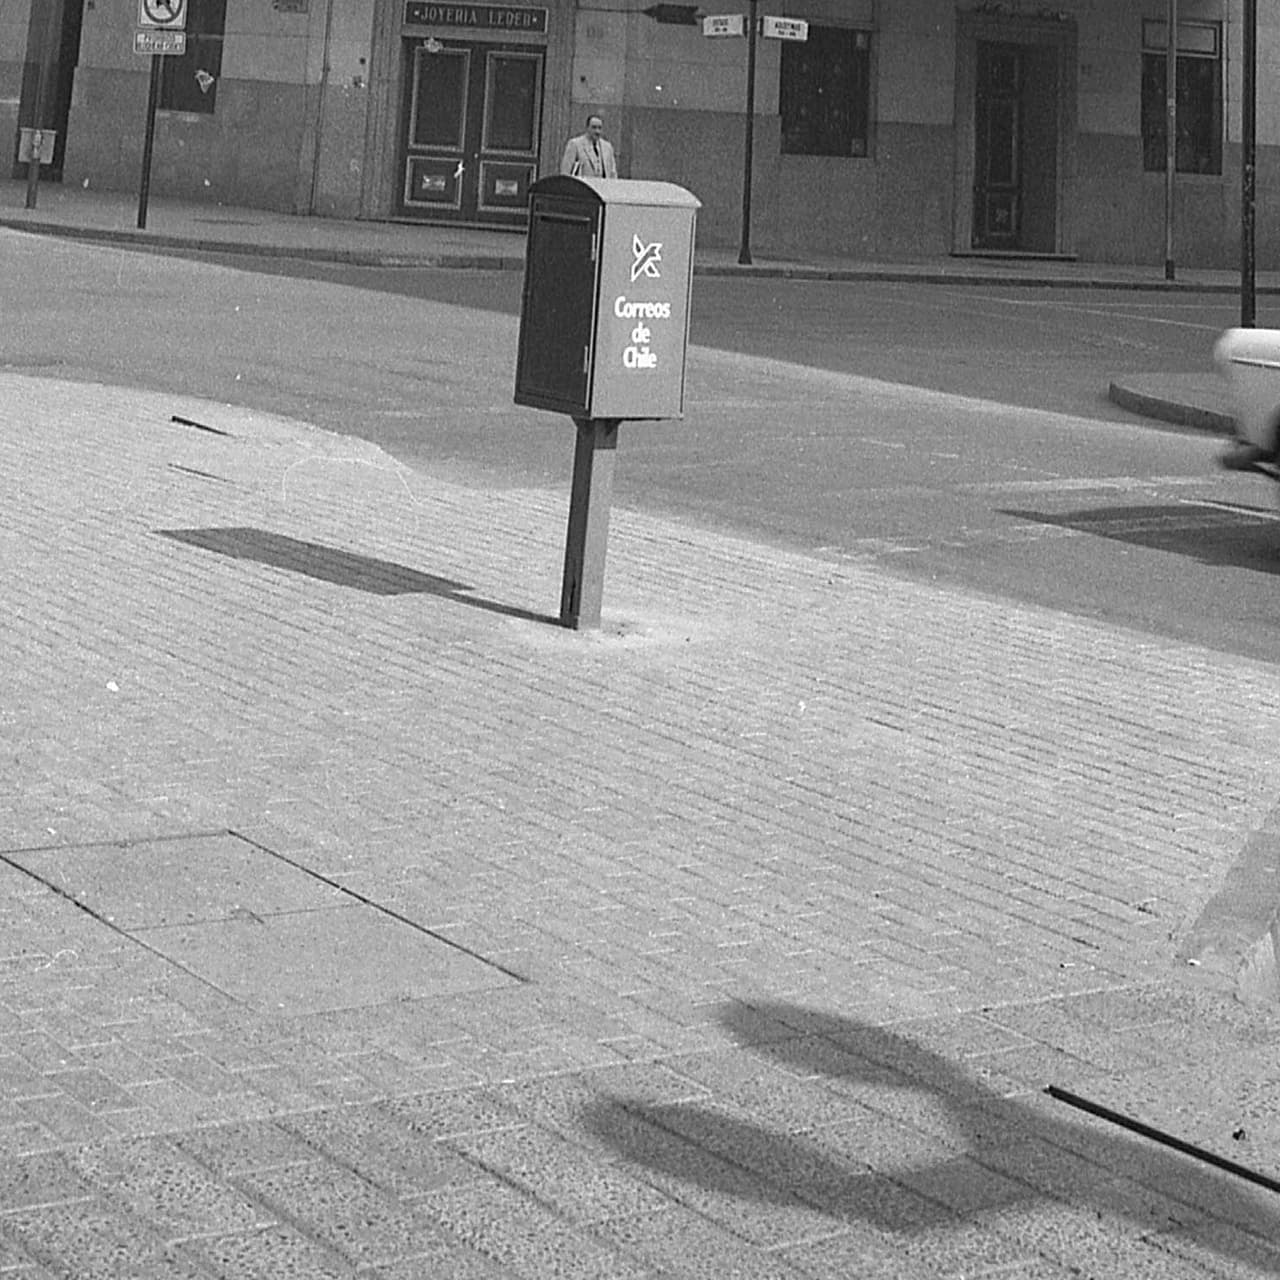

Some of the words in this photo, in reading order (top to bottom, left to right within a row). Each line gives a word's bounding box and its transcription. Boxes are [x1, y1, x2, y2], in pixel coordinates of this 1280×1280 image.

[419, 6, 478, 24] JOYERIA
[614, 295, 671, 319] Correos
[631, 320, 651, 343] de
[623, 346, 658, 368] Chile
